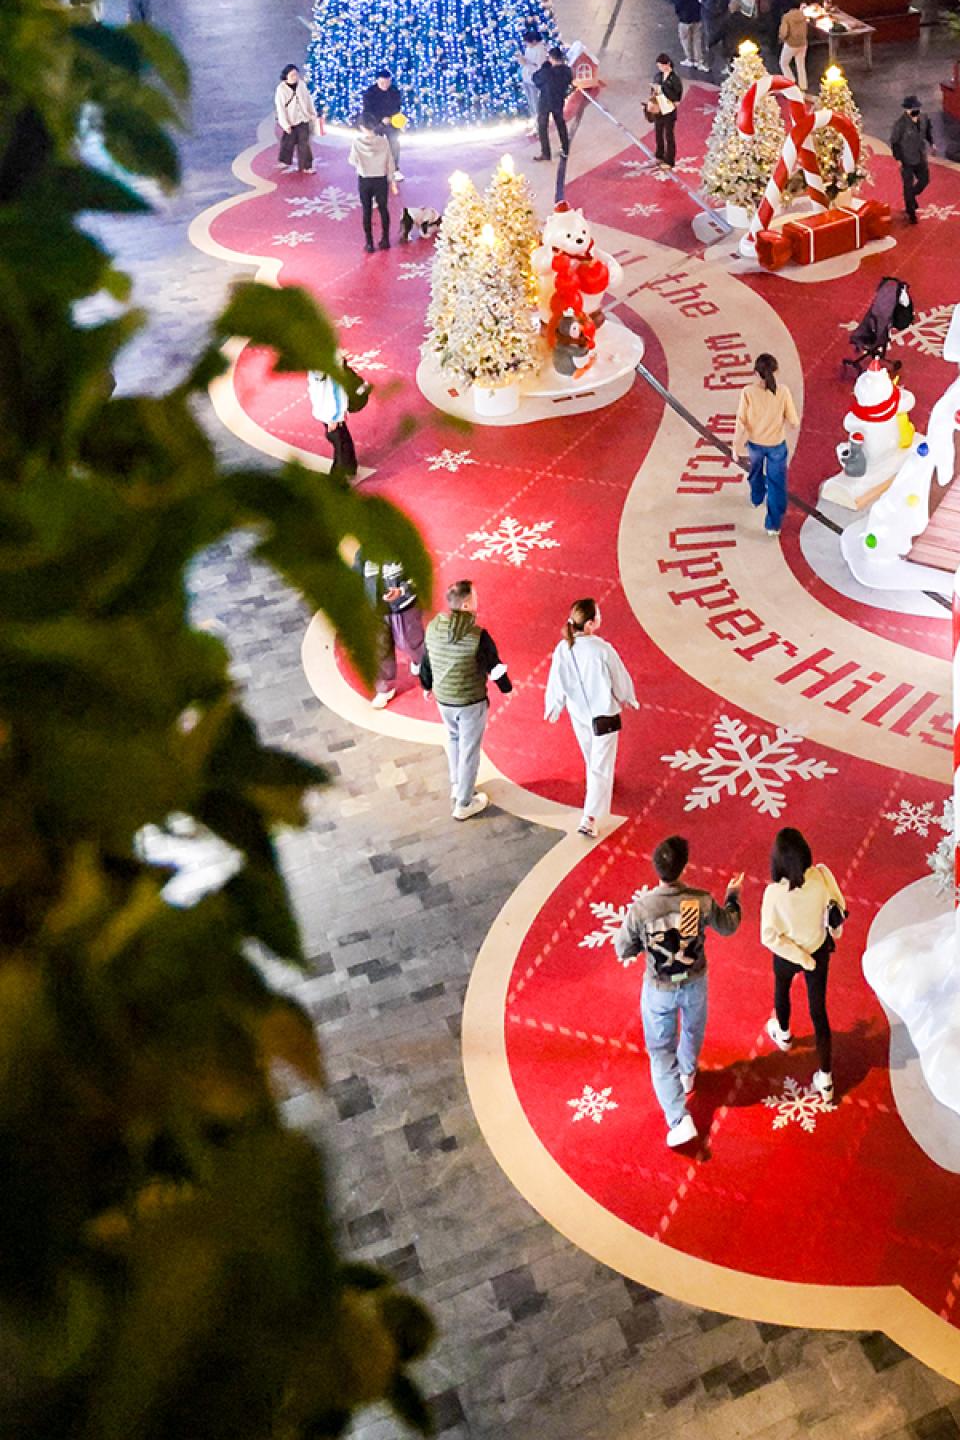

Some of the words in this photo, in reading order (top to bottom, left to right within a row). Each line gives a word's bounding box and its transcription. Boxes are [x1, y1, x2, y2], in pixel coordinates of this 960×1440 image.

[611, 249, 648, 266] ll
[648, 271, 720, 319] the
[703, 331, 756, 391] way
